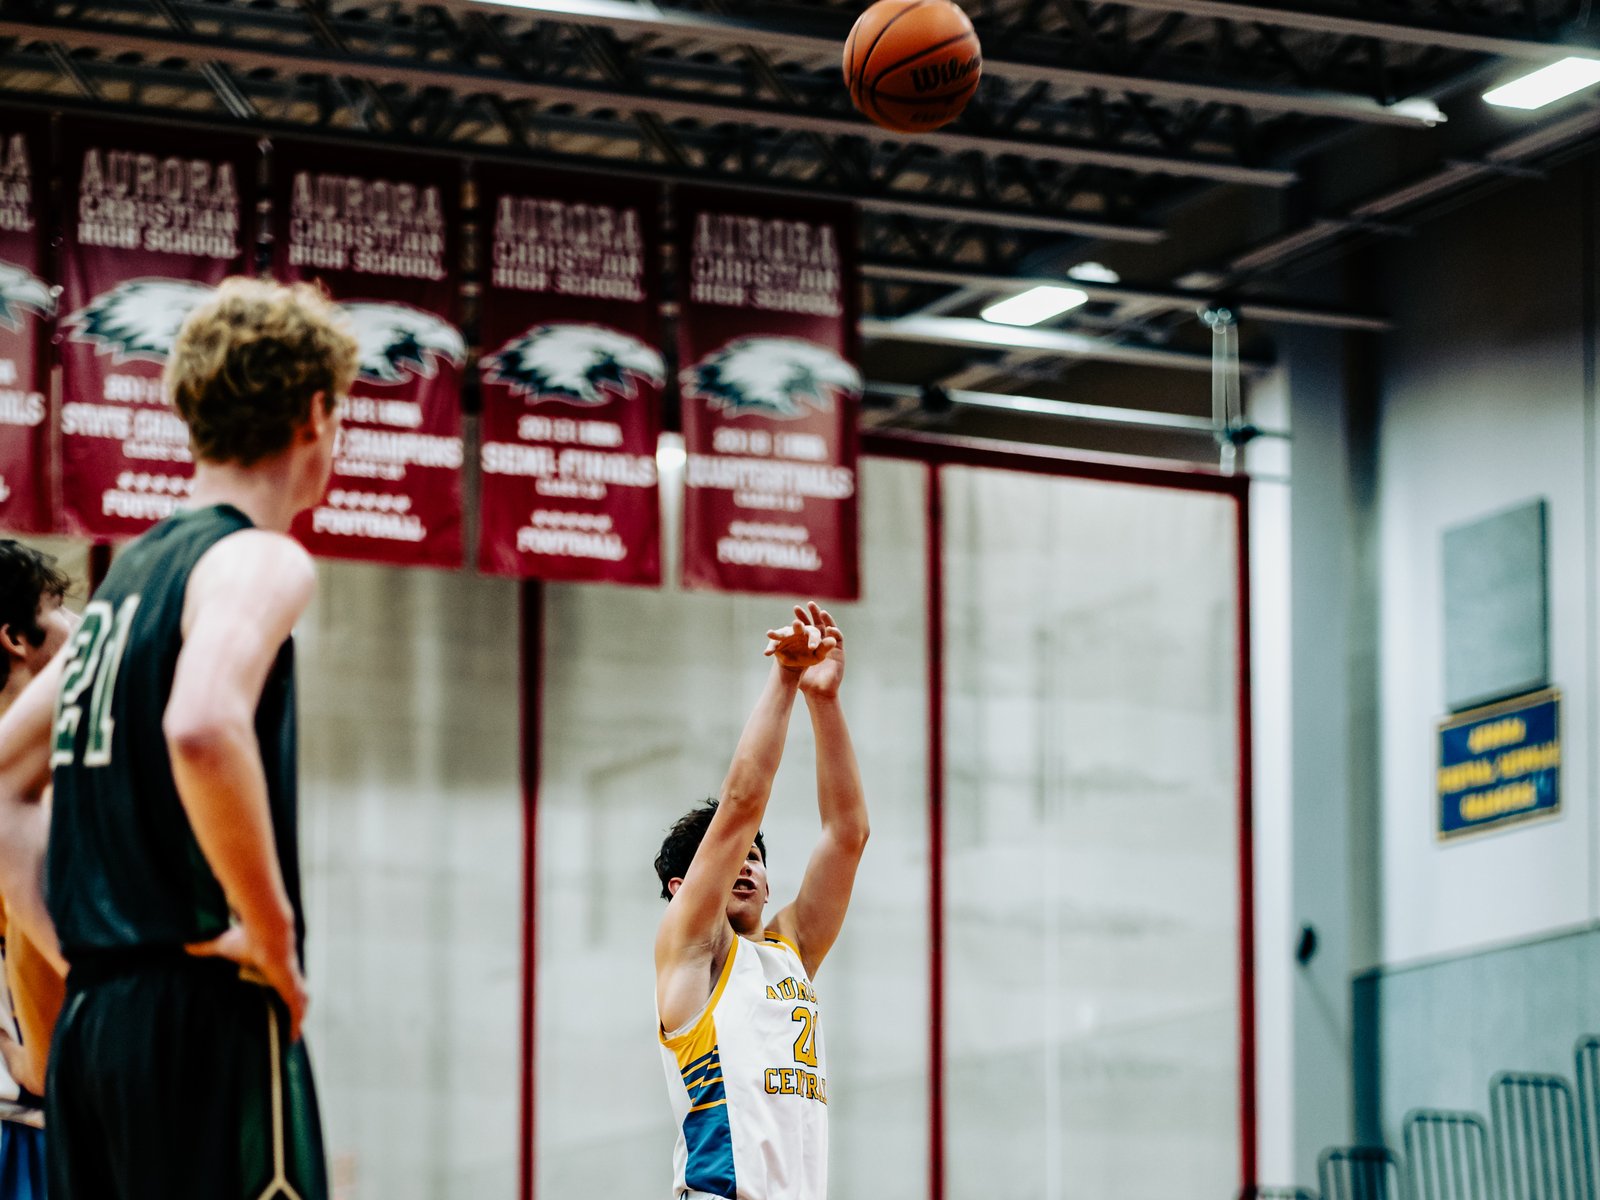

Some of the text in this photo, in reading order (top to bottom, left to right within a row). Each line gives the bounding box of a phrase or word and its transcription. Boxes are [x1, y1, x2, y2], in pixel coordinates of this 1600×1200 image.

[81, 149, 239, 207] AURORA
[291, 172, 443, 231] AURORA
[80, 194, 239, 232] CHRISTIAN
[495, 196, 642, 251] AURORA
[78, 223, 241, 259] HIGH SCHOOL
[290, 217, 445, 258] CHRISTIAN
[288, 243, 447, 281] HIGH SCHOOL
[49, 593, 141, 768] 21
